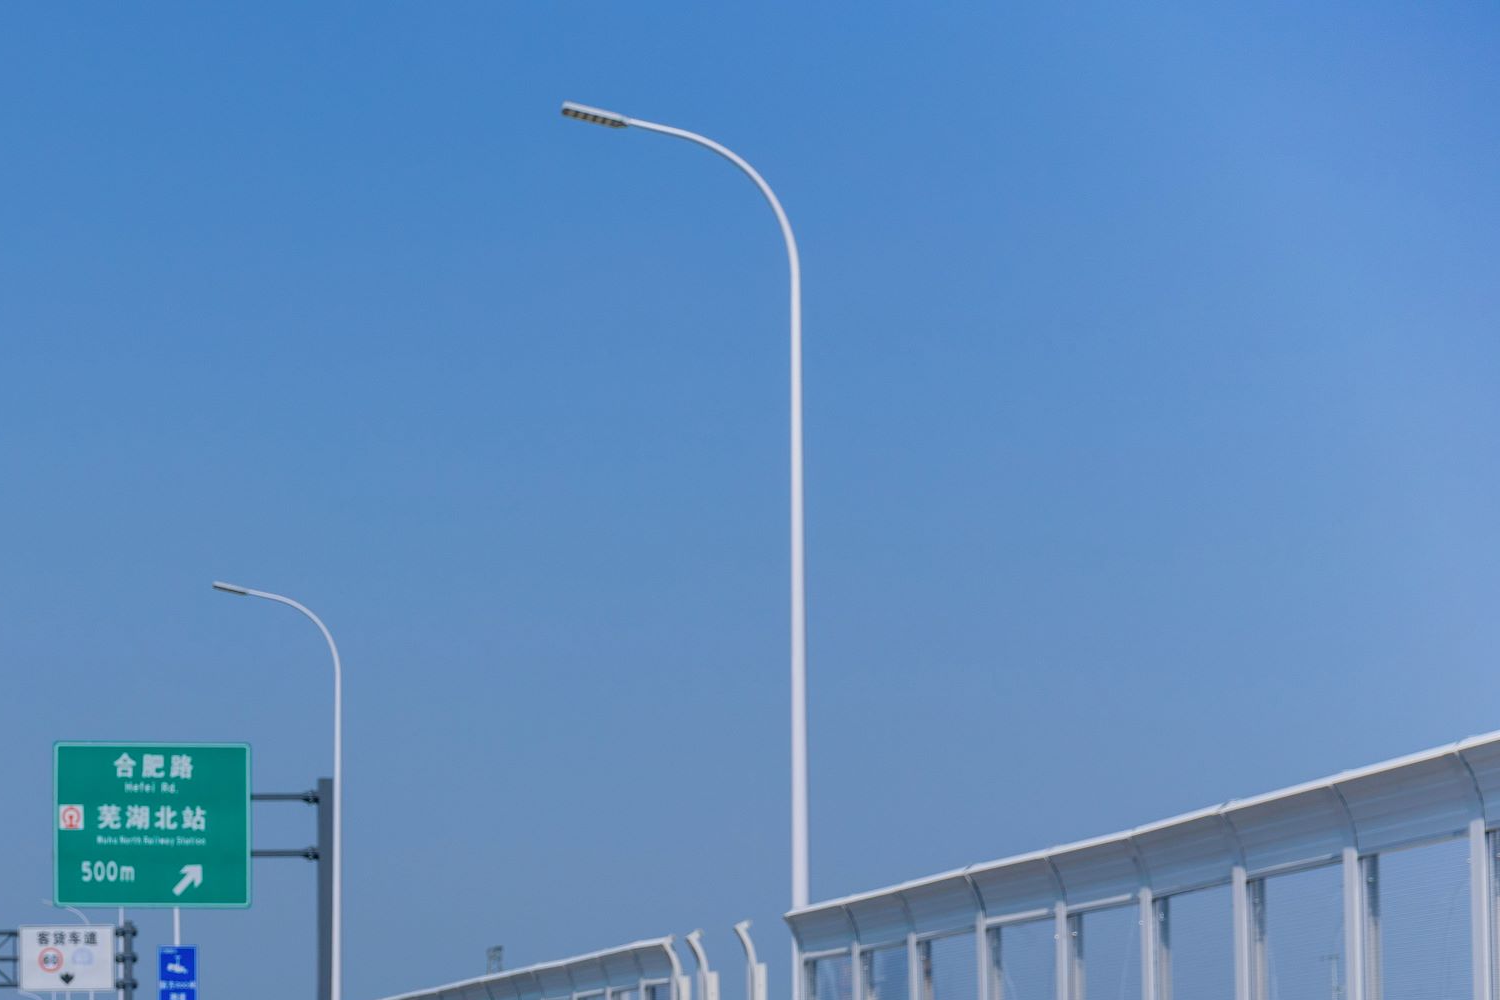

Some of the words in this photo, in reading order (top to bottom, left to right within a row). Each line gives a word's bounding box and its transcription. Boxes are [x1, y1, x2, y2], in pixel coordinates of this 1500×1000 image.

[114, 752, 193, 779] 合肥路
[124, 782, 155, 793] Hefei
[160, 782, 179, 793] Rd.
[97, 804, 207, 830] 芜湖北站
[81, 860, 135, 882] 500m
